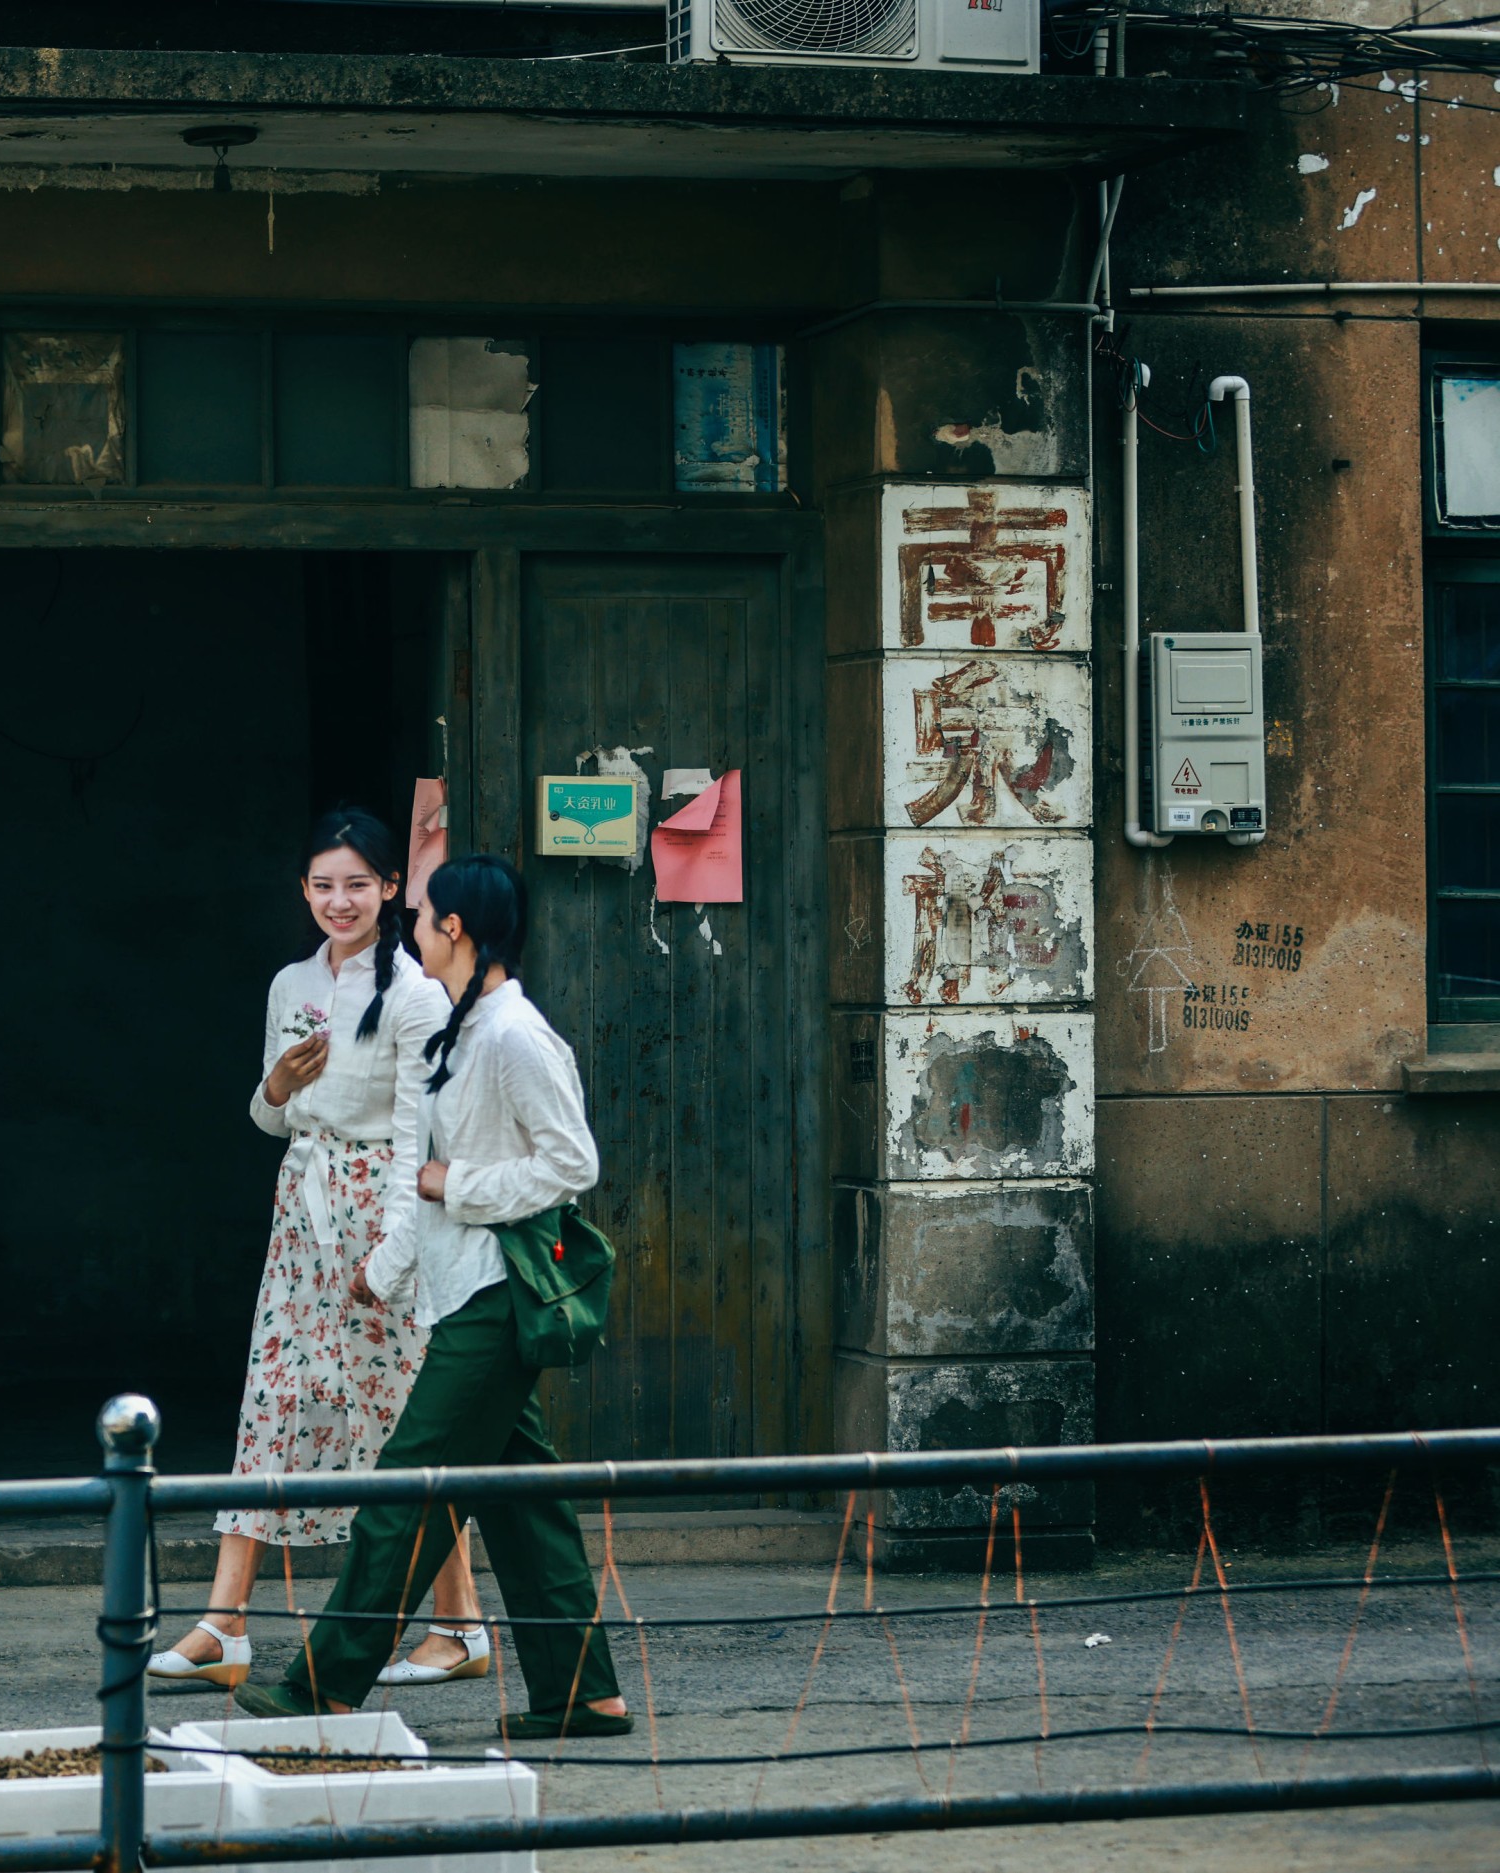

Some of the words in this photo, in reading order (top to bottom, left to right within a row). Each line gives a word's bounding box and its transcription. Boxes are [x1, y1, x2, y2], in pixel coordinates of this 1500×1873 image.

[1181, 717, 1209, 726] 计量设备
[1212, 717, 1240, 725] 严禁拆封
[1174, 787, 1199, 795] 有电危险
[563, 796, 617, 811] 天资乳业
[1235, 920, 1271, 941] 办证
[1274, 923, 1304, 947] 155
[1233, 942, 1303, 973] 81310019
[1183, 982, 1217, 1003] 办证
